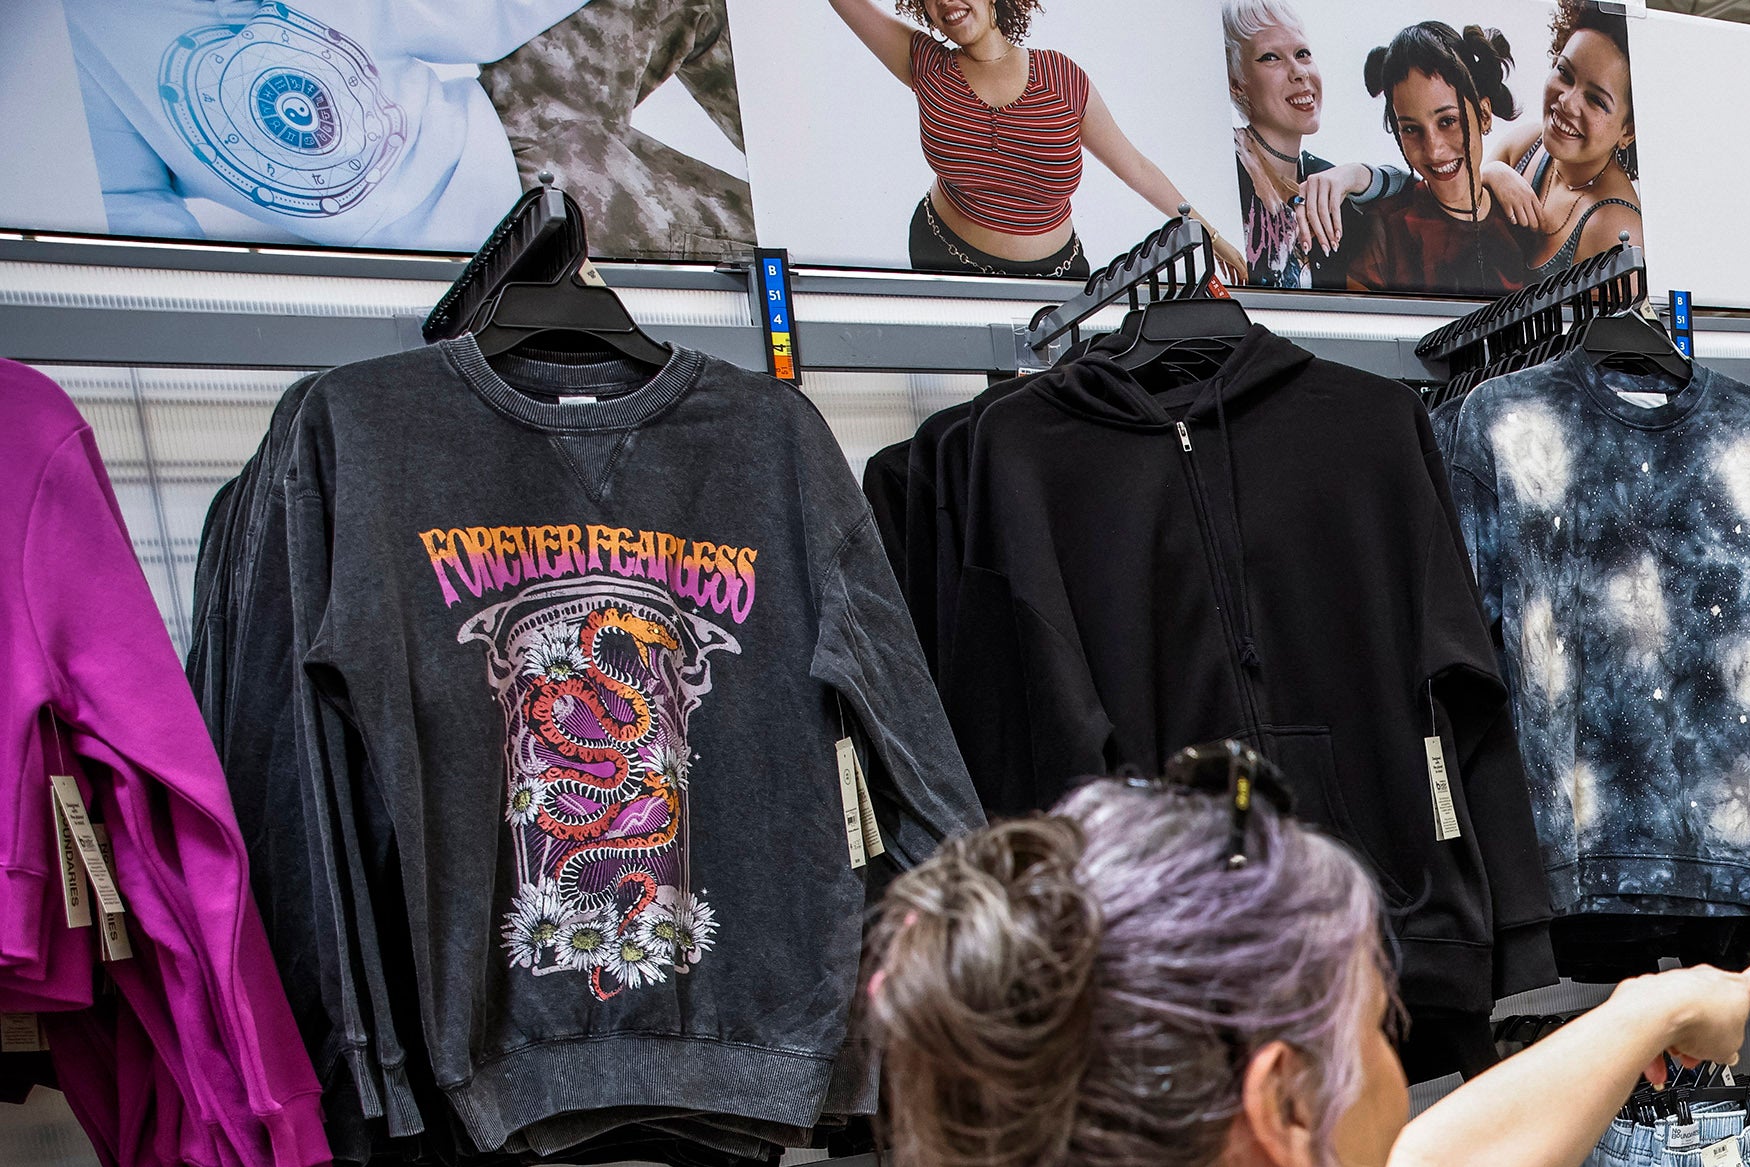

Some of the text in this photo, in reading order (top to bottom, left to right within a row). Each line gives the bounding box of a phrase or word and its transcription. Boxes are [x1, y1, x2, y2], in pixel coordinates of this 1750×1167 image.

[768, 265, 777, 276] B
[768, 290, 781, 301] 51
[1677, 296, 1683, 306] B
[773, 314, 783, 325] 4
[1677, 315, 1685, 324] 51
[1680, 341, 1686, 351] 3
[418, 524, 758, 625] FOREVER FEARLESS
